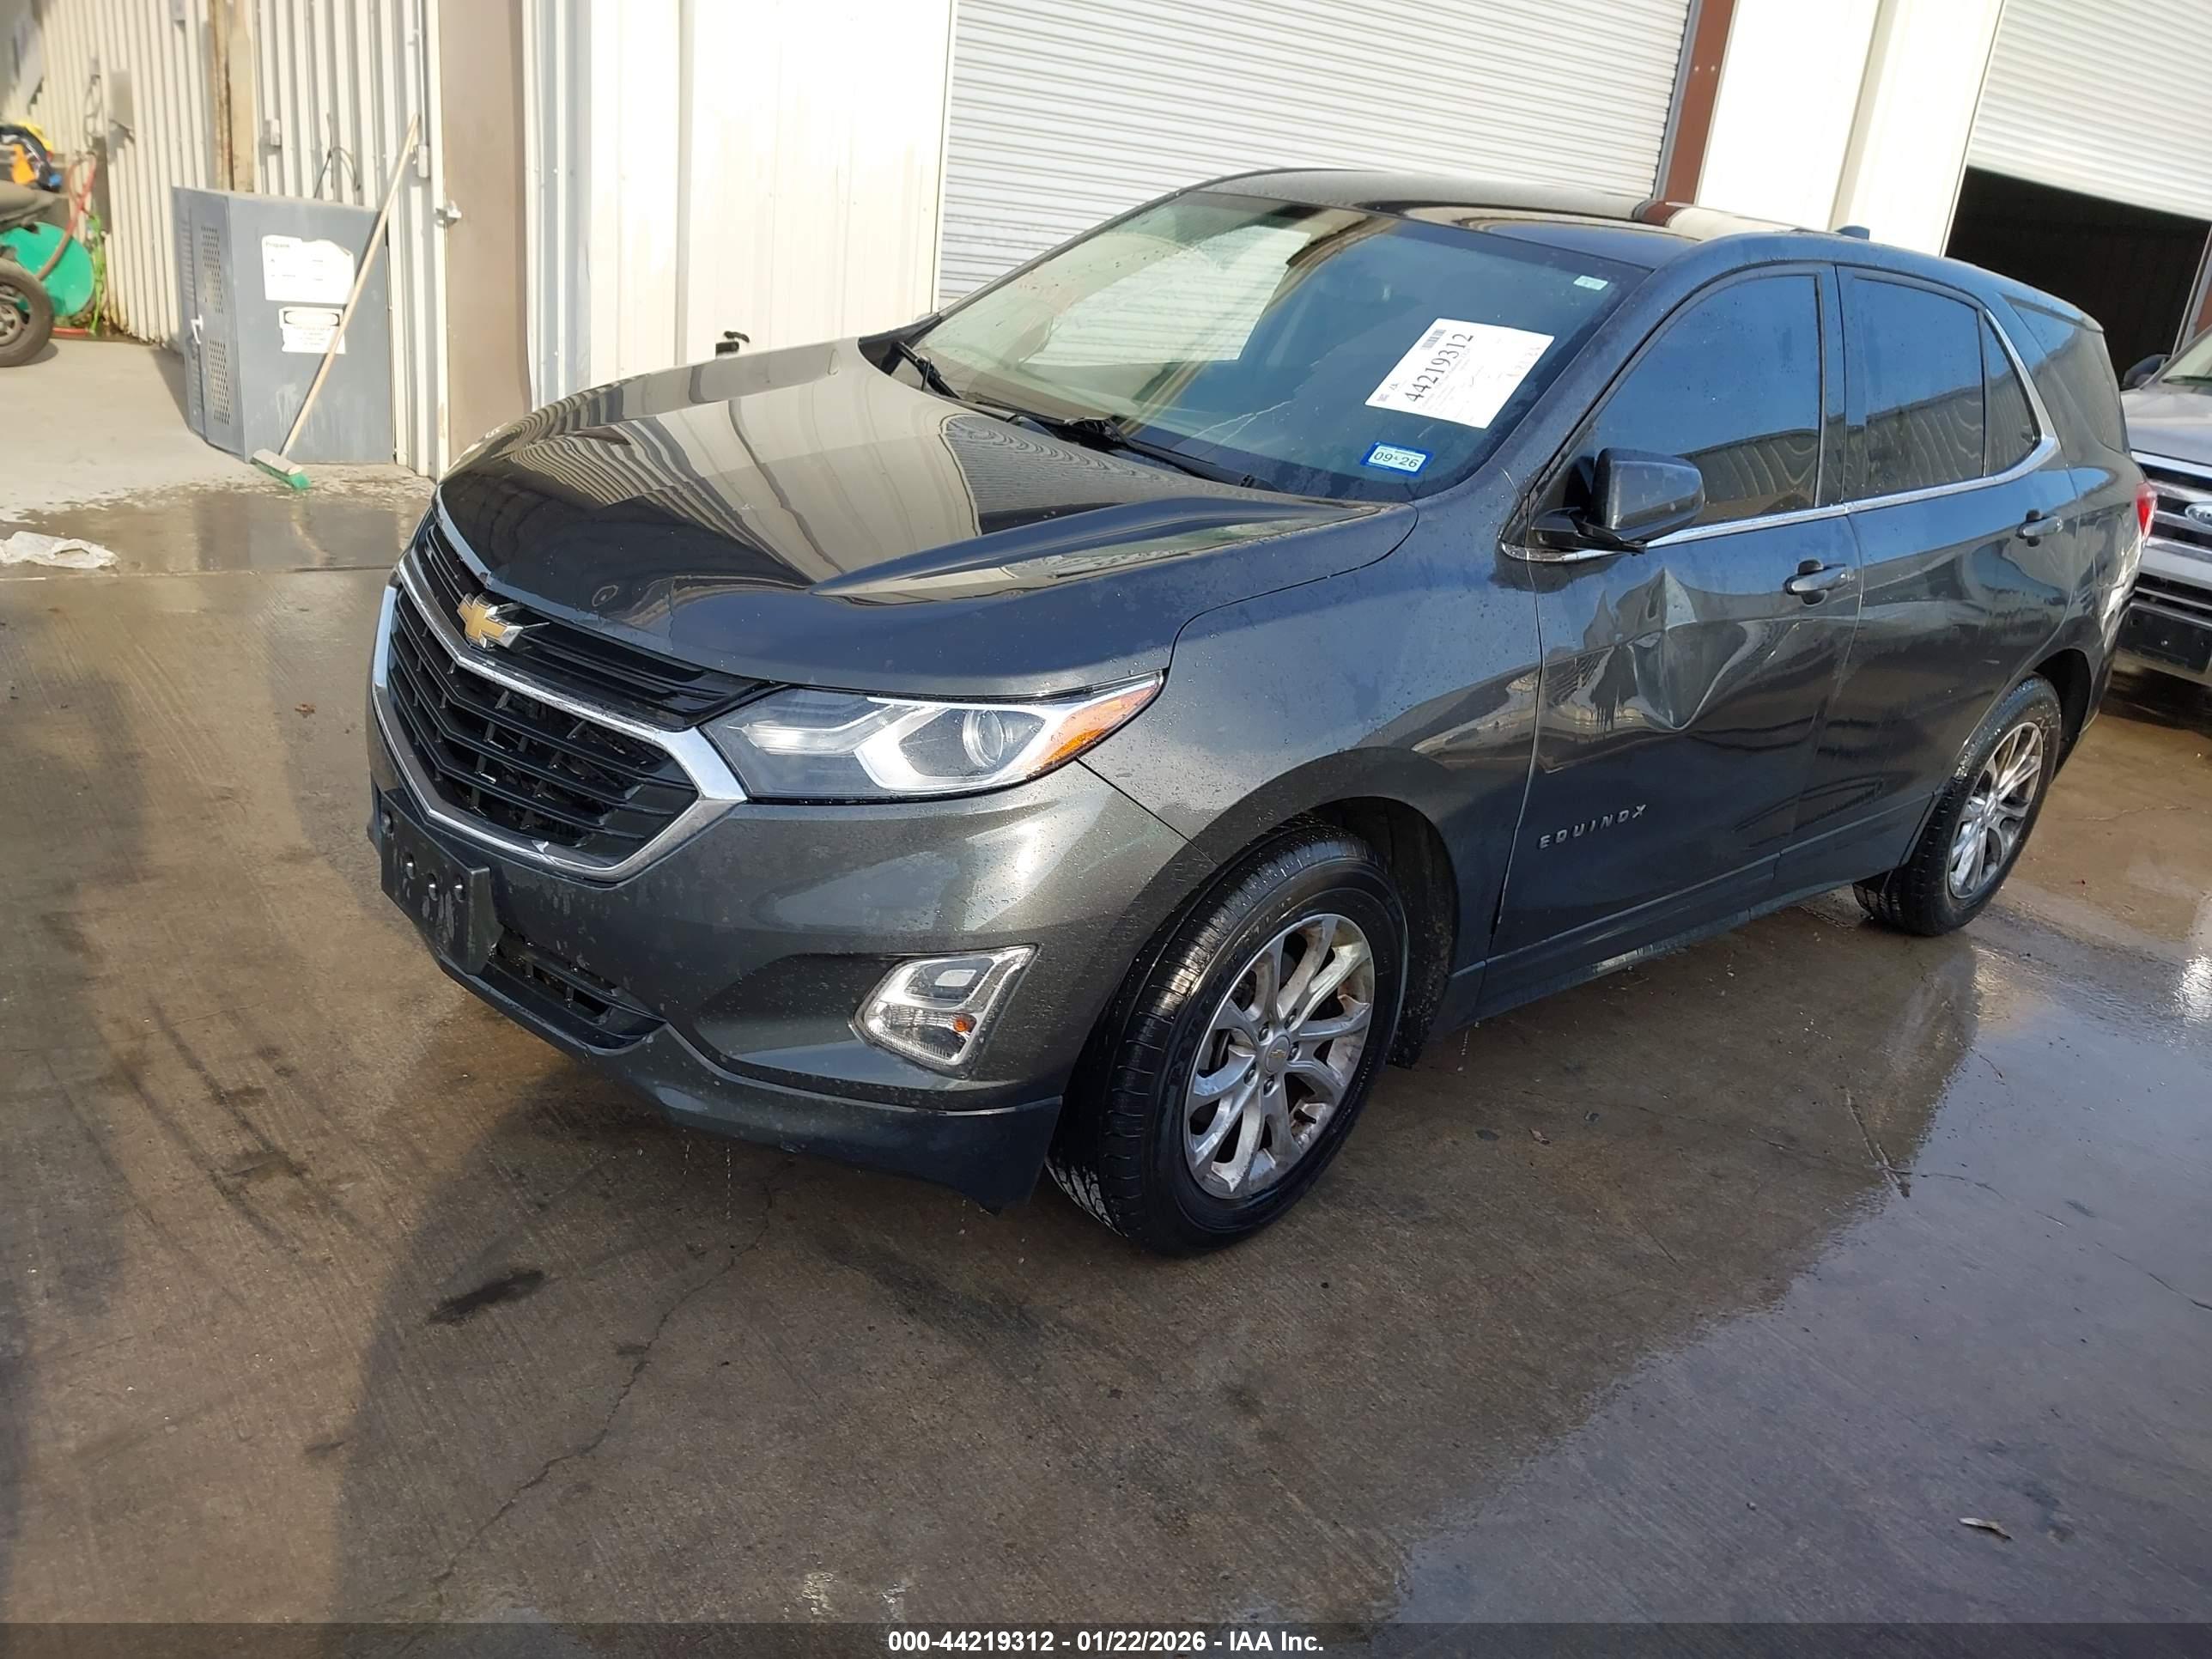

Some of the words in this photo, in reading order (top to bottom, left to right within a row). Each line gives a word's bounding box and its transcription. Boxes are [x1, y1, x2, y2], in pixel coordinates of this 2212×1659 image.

[1404, 333, 1474, 403] 44219312
[1374, 452, 1393, 462] 09
[1399, 456, 1419, 468] 26
[1539, 804, 1647, 849] EQUINOX
